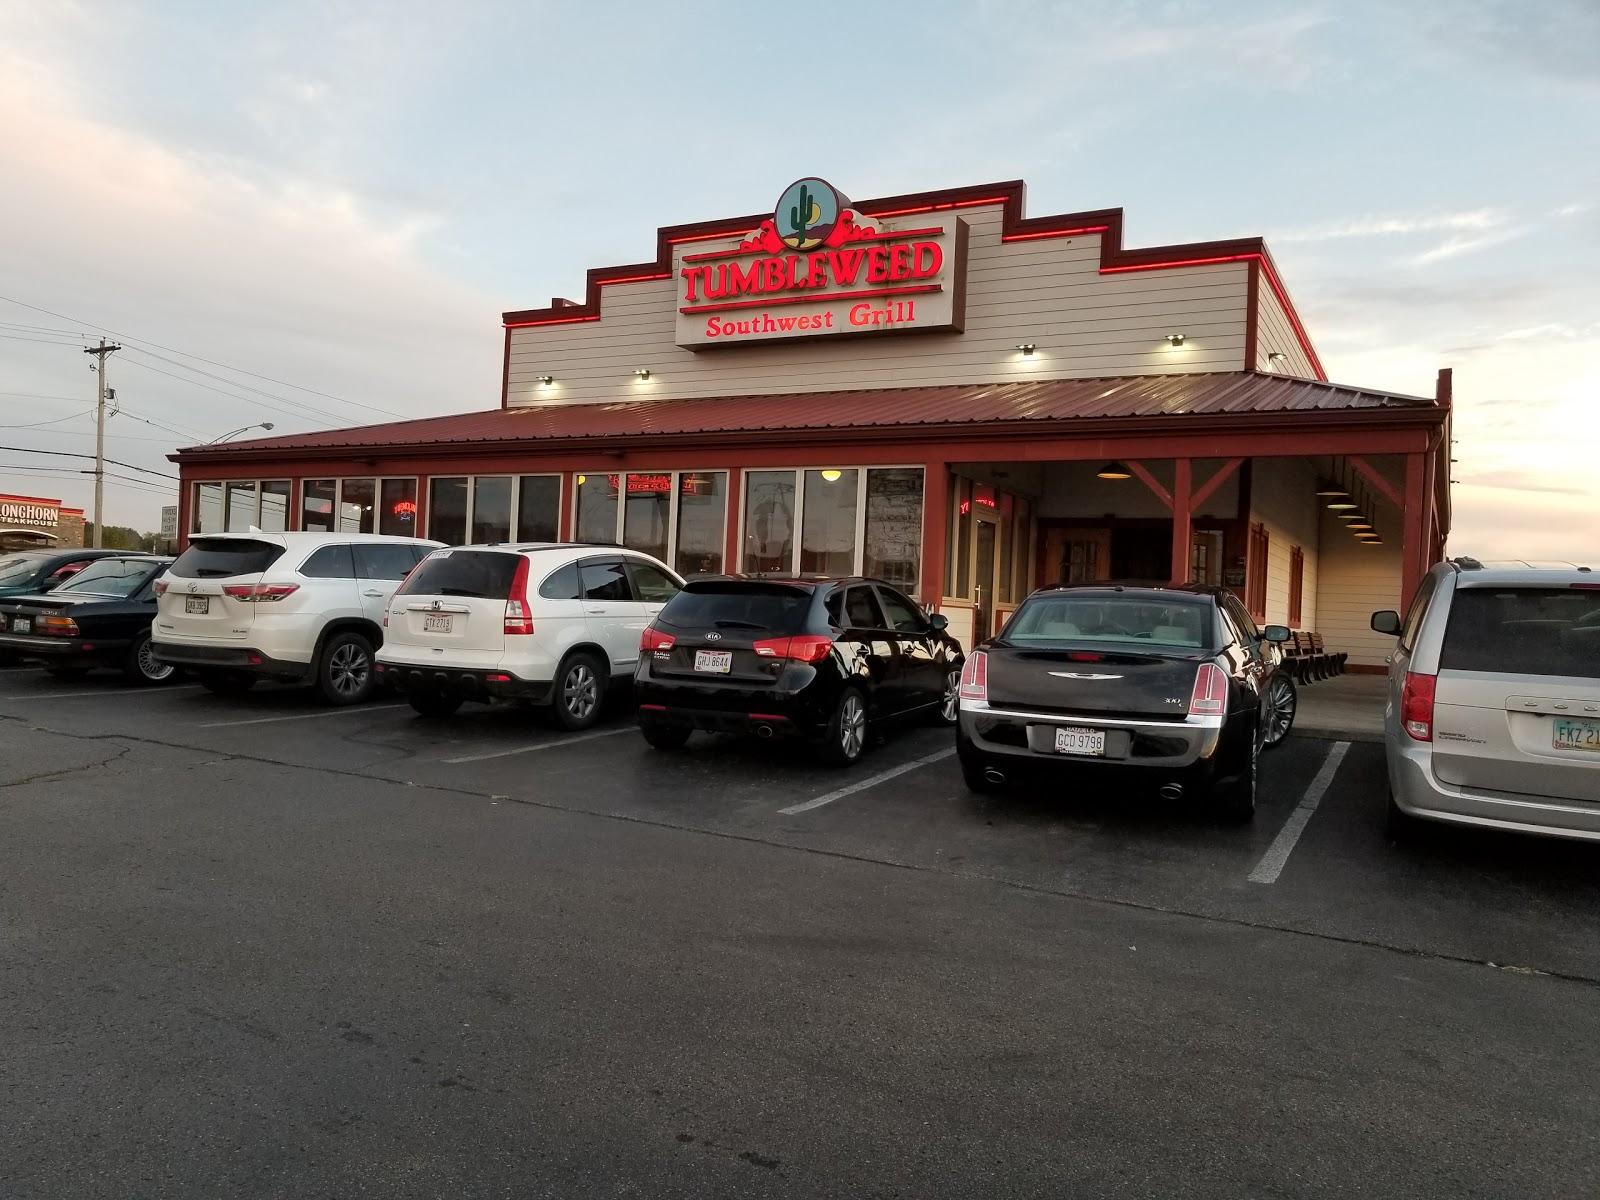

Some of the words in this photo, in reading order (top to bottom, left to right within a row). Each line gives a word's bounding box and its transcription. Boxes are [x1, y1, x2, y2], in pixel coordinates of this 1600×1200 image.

[681, 241, 943, 302] TUMBLEWEED
[705, 311, 834, 339] Southwest
[848, 300, 915, 327] Grill
[0, 503, 58, 521] ONGHORN
[0, 516, 58, 528] TEAKHOUSE
[697, 655, 711, 667] GHJ
[711, 656, 729, 668] 8644
[1058, 733, 1076, 747] GCD
[1078, 735, 1102, 750] 9798
[1559, 726, 1582, 743] FKZ
